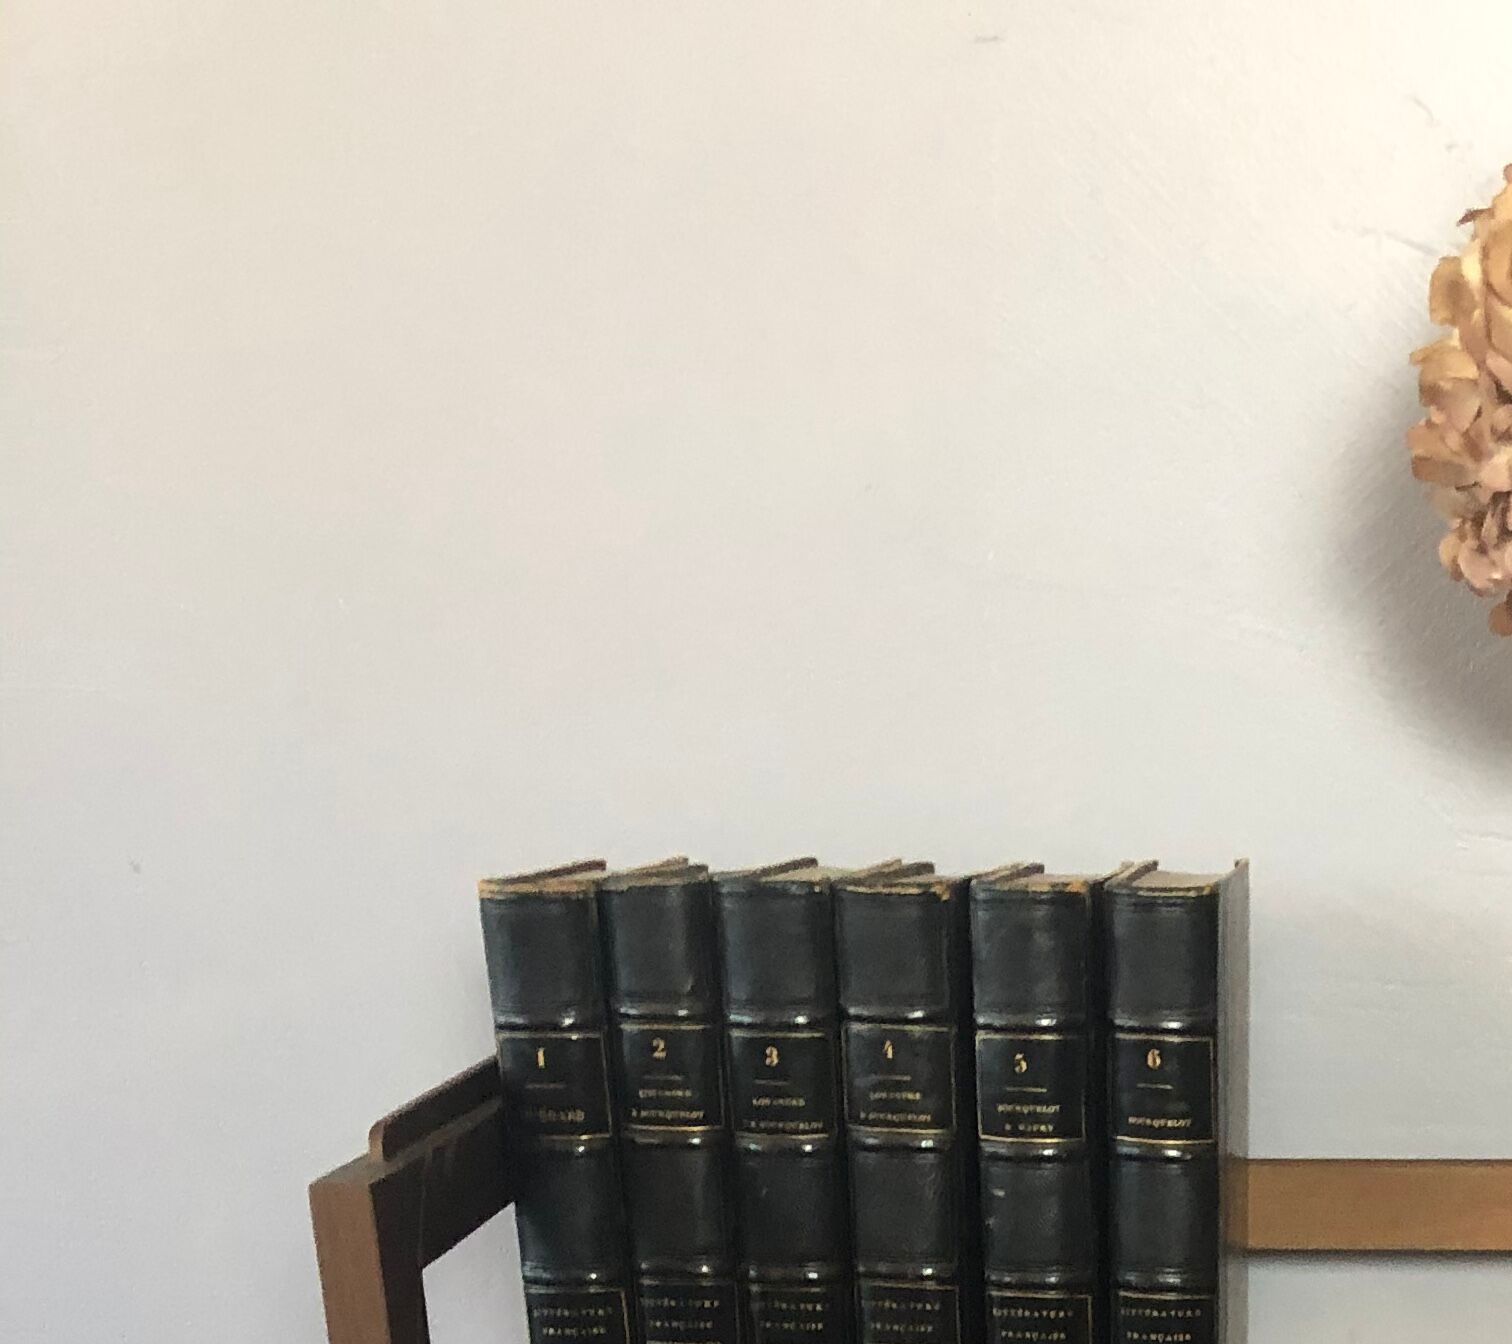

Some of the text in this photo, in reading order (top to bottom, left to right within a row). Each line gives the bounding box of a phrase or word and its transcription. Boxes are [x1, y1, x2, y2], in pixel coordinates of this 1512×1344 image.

[534, 1047, 546, 1069] 1
[652, 1037, 667, 1060] 2
[764, 1045, 780, 1067] 3
[883, 1039, 894, 1060] 4
[1146, 1048, 1161, 1070] 6
[1013, 1052, 1028, 1074] 5
